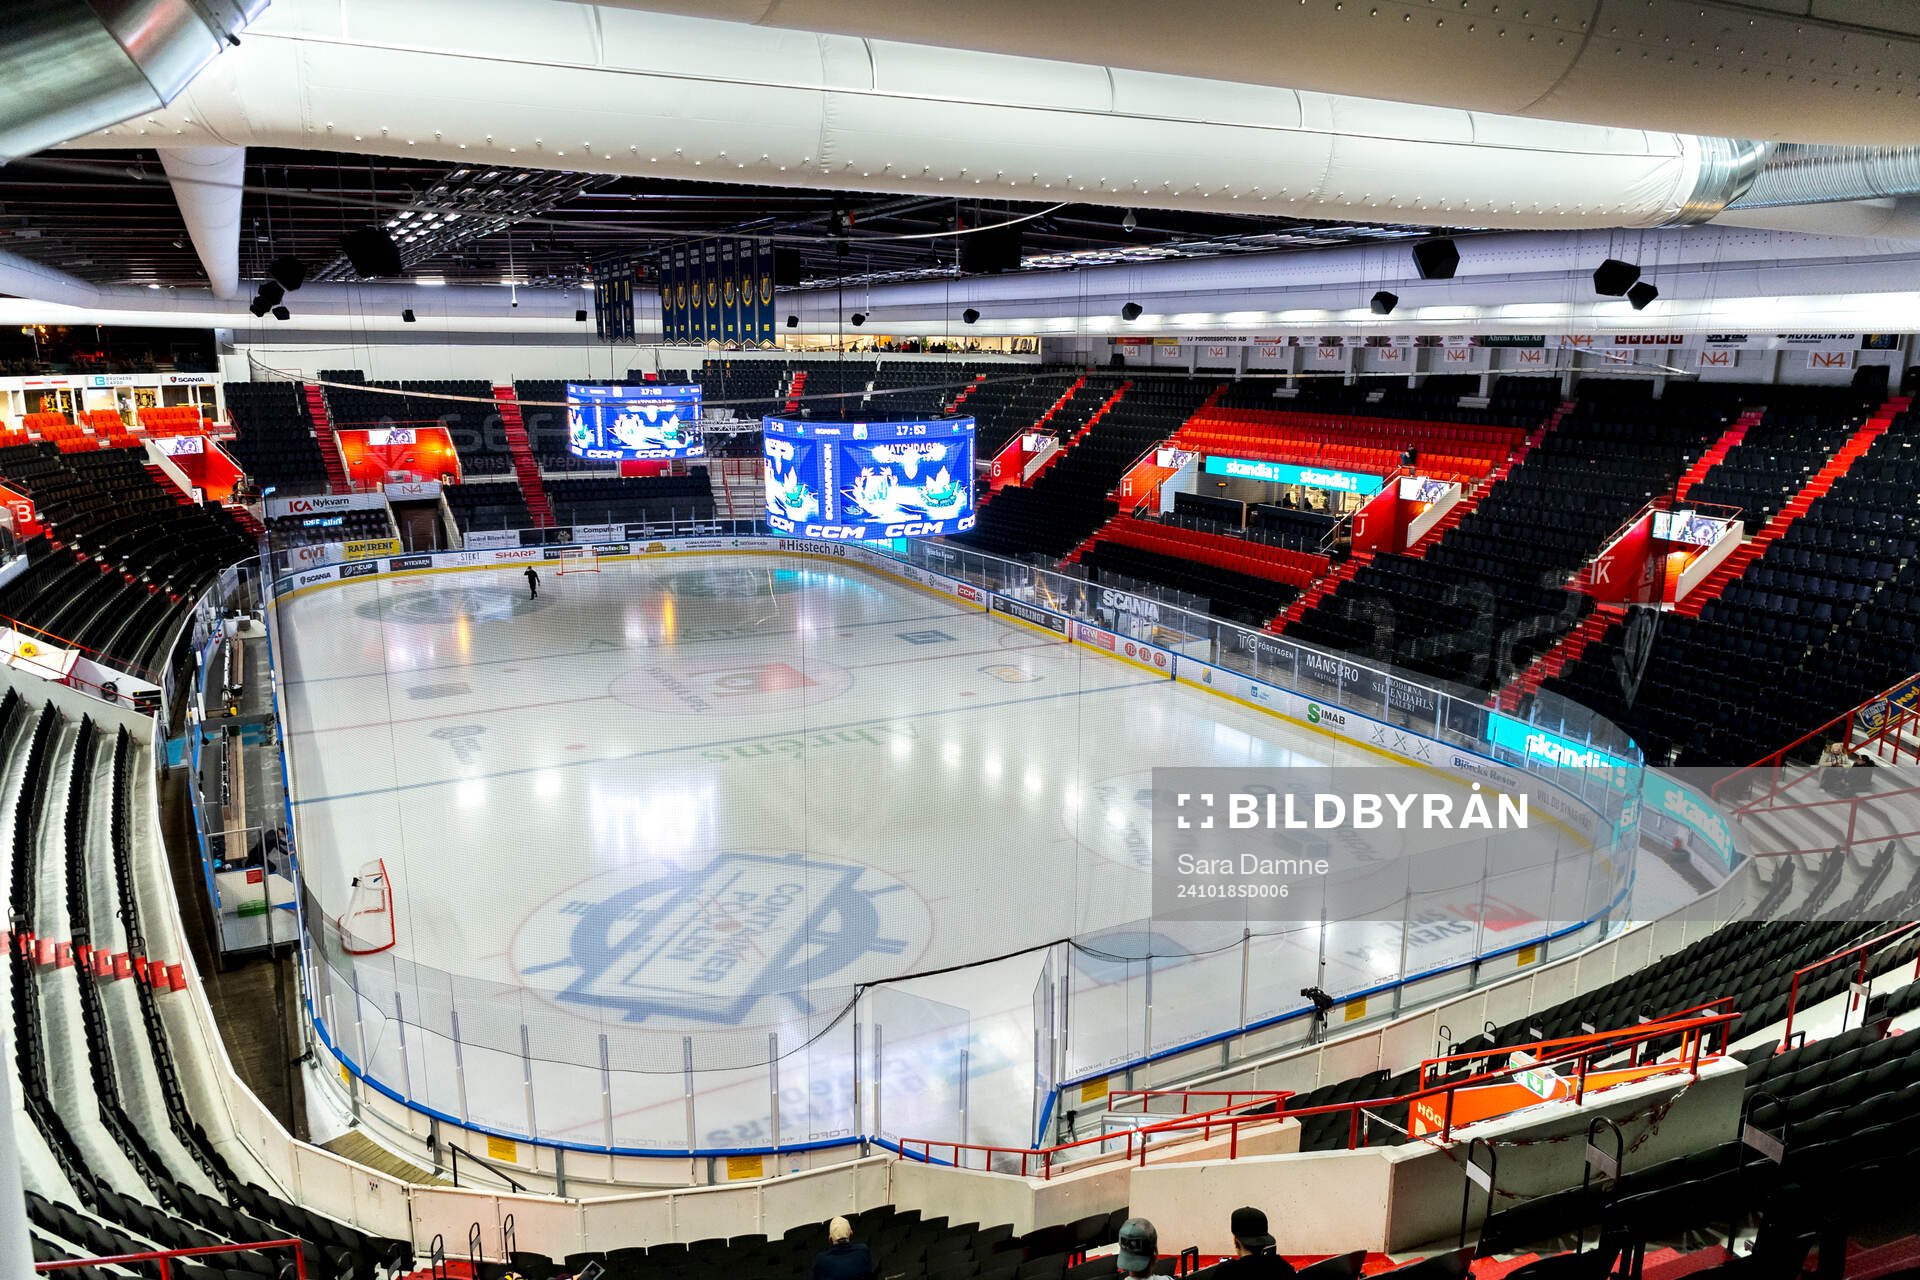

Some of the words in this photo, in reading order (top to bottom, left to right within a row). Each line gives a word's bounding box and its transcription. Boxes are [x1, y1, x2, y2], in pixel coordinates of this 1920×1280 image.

[1701, 352, 1729, 366] N4
[1812, 352, 1846, 367] N4
[896, 426, 926, 436] 17:53
[587, 450, 623, 458] CCM
[636, 449, 676, 458] CCM
[993, 464, 1001, 476] G
[1122, 482, 1132, 496] H
[16, 504, 32, 522] B
[289, 500, 313, 512] ICA
[313, 498, 349, 508] Nykvarn
[806, 526, 866, 539] CCM
[885, 521, 944, 537] CCM
[1356, 516, 1365, 536] J
[348, 542, 393, 552] RAMIRENT
[787, 540, 830, 555] Hisstech
[833, 545, 845, 556] AB
[307, 572, 332, 582] SCANIA
[1596, 561, 1611, 584] K
[1102, 589, 1159, 622] SCANIA
[1258, 641, 1294, 659] FÖRETAGEN
[1306, 654, 1358, 682] MÅNSBRO
[1372, 682, 1434, 710] SILENDAHLS
[1307, 702, 1345, 725] SIMAB
[1454, 757, 1489, 776] Björcks
[1490, 769, 1516, 787] Resor
